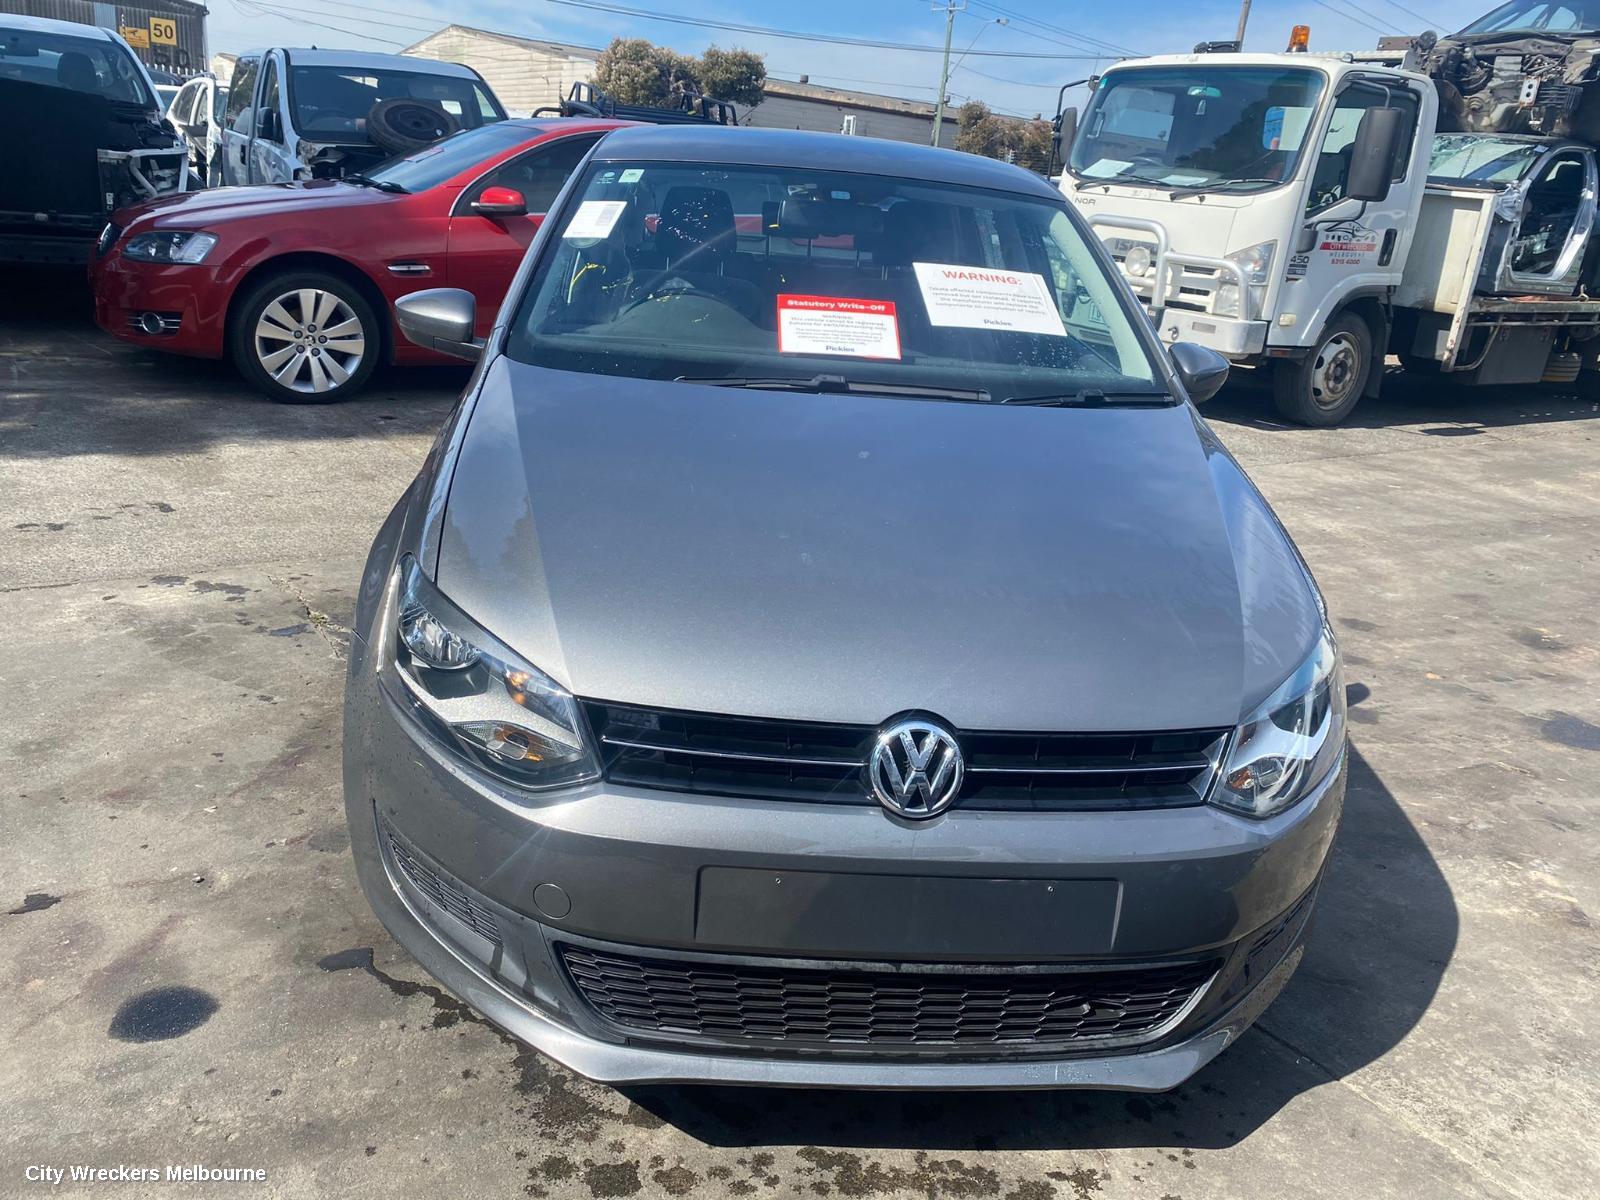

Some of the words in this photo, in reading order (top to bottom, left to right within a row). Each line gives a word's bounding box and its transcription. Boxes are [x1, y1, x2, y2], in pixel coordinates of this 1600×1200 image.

[153, 23, 174, 39] 50
[1290, 255, 1310, 264] 450
[943, 270, 1023, 285] WARNING:
[787, 300, 836, 309] Statutory
[838, 302, 886, 311] Write-Off
